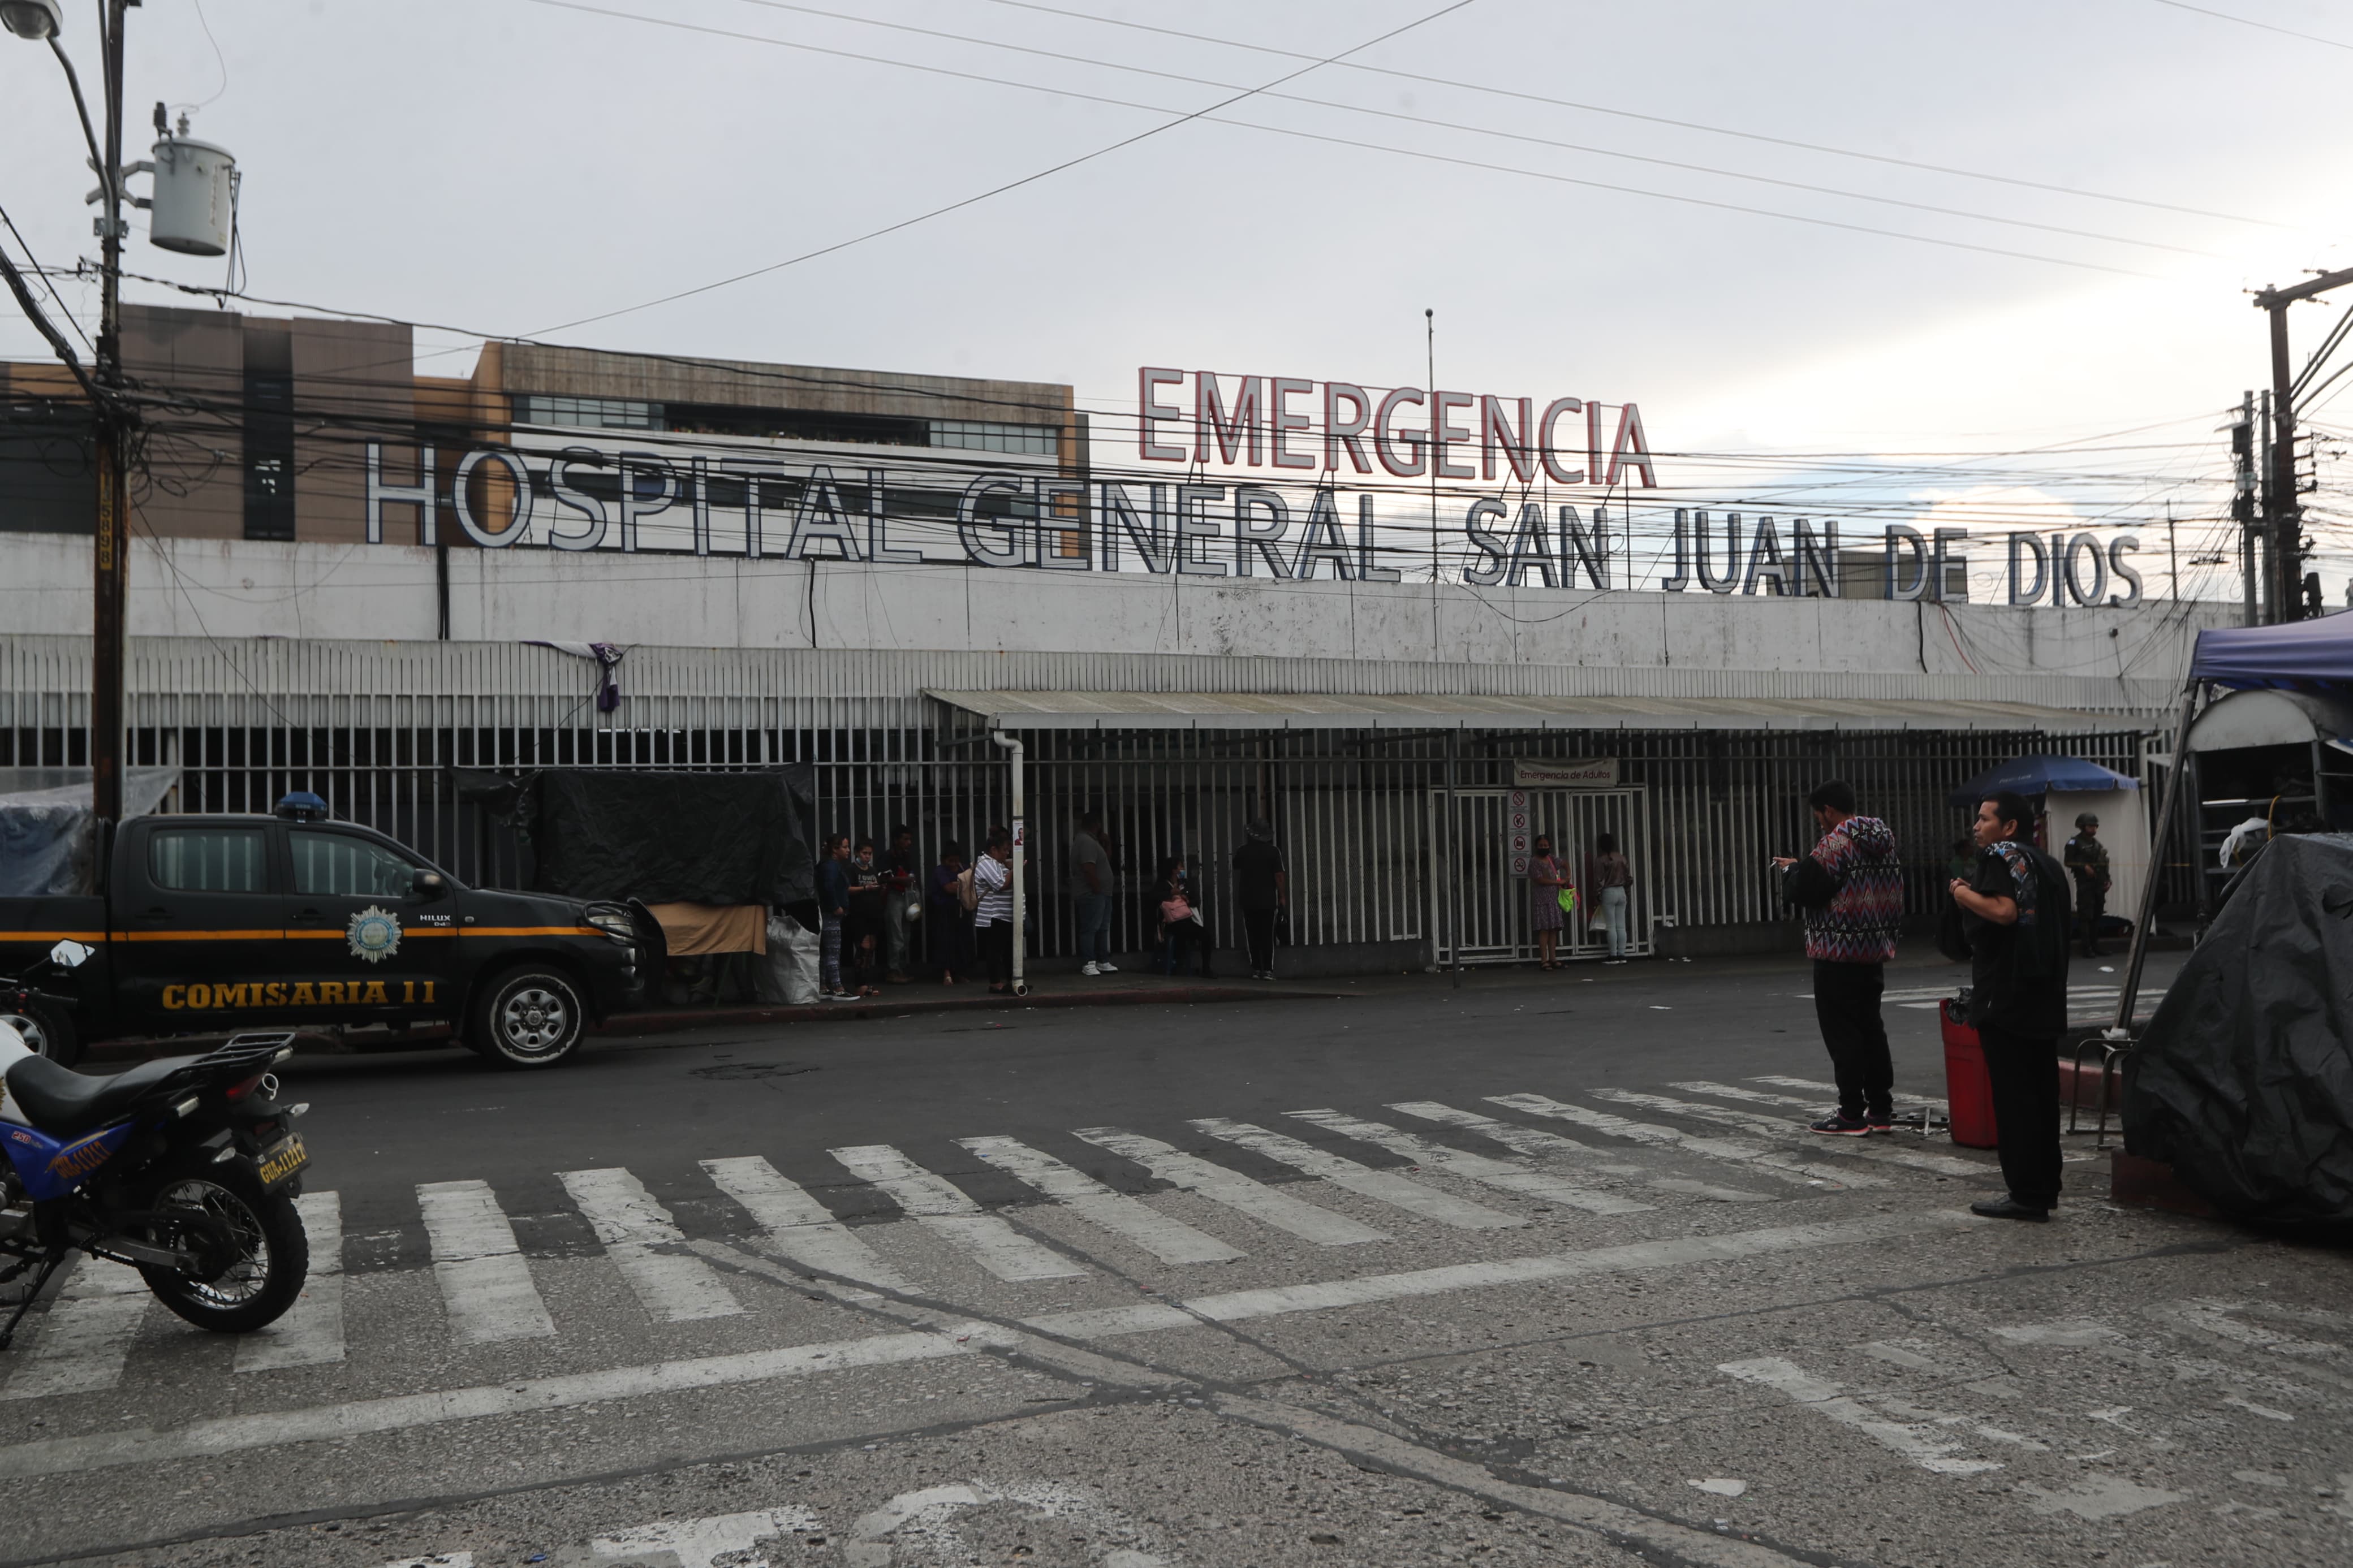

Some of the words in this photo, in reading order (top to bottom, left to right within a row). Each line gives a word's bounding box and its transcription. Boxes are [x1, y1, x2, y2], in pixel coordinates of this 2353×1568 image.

[1138, 366, 1657, 488] EMERGENCIA
[365, 438, 922, 563] HOSPITAL
[956, 472, 1401, 582] GENERAL
[1463, 499, 1609, 590] SAN
[1662, 508, 1839, 598] JUAN
[1885, 524, 1968, 604] DE
[2009, 532, 2143, 608] DIOS
[1520, 770, 1568, 781] Emergencia
[1570, 771, 1581, 779] de
[1583, 770, 1611, 779] Adultos
[162, 981, 387, 1010] COMISARIA
[403, 980, 436, 1004] 11
[11, 1130, 32, 1144] 250
